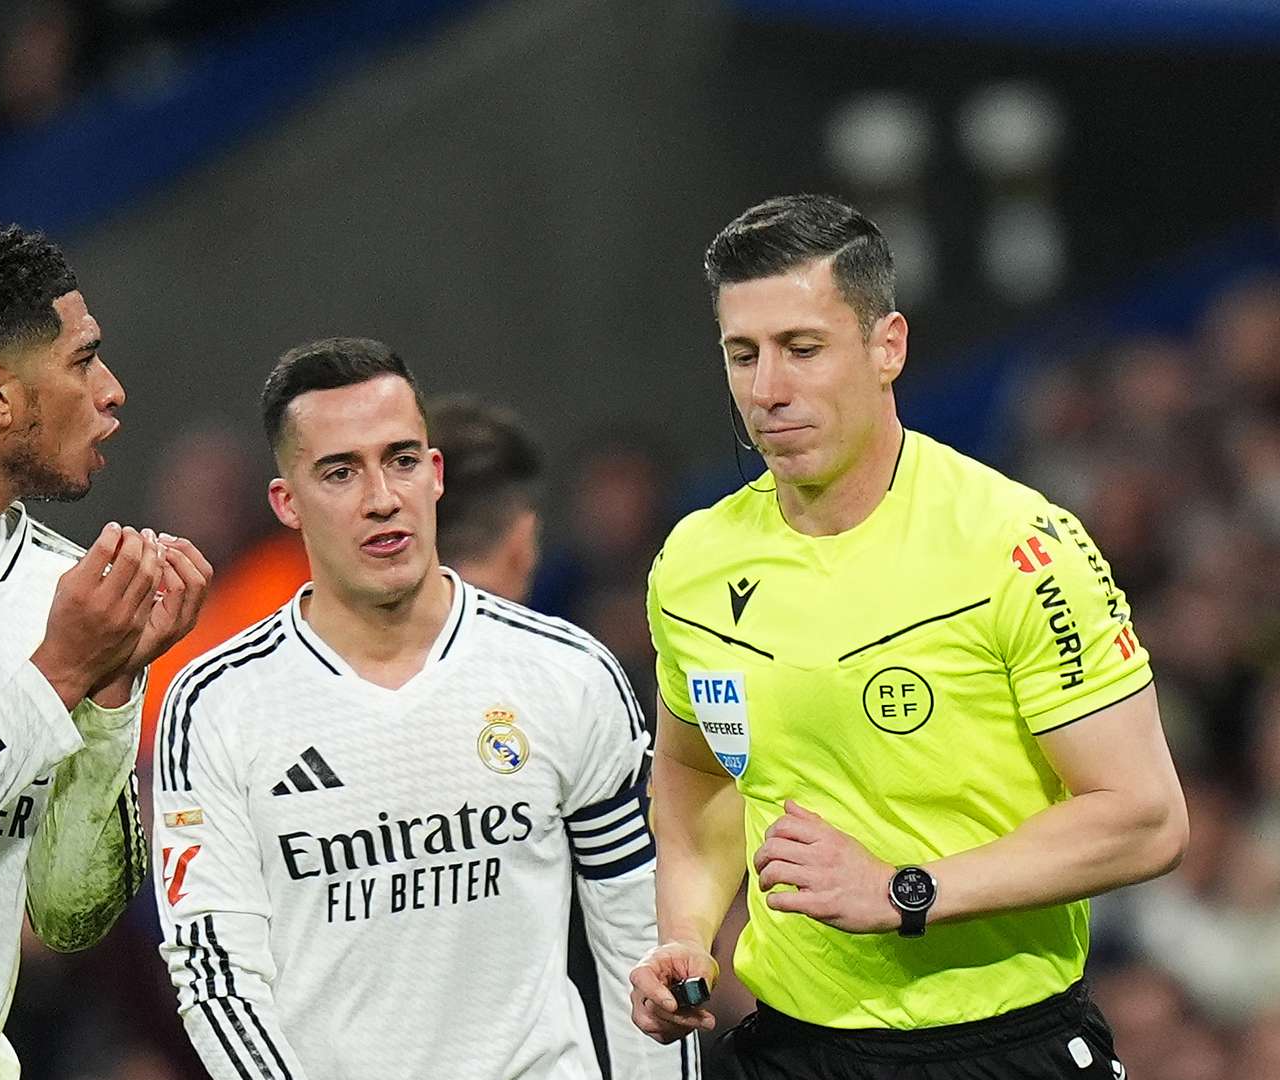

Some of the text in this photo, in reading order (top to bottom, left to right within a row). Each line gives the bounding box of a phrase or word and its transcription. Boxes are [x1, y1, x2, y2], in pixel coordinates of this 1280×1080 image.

[1035, 575, 1085, 691] WÜRTH
[692, 679, 740, 704] FIFA
[702, 721, 745, 736] REFEREE
[278, 801, 533, 881] Emirates
[328, 857, 502, 923] FLY BETTER
